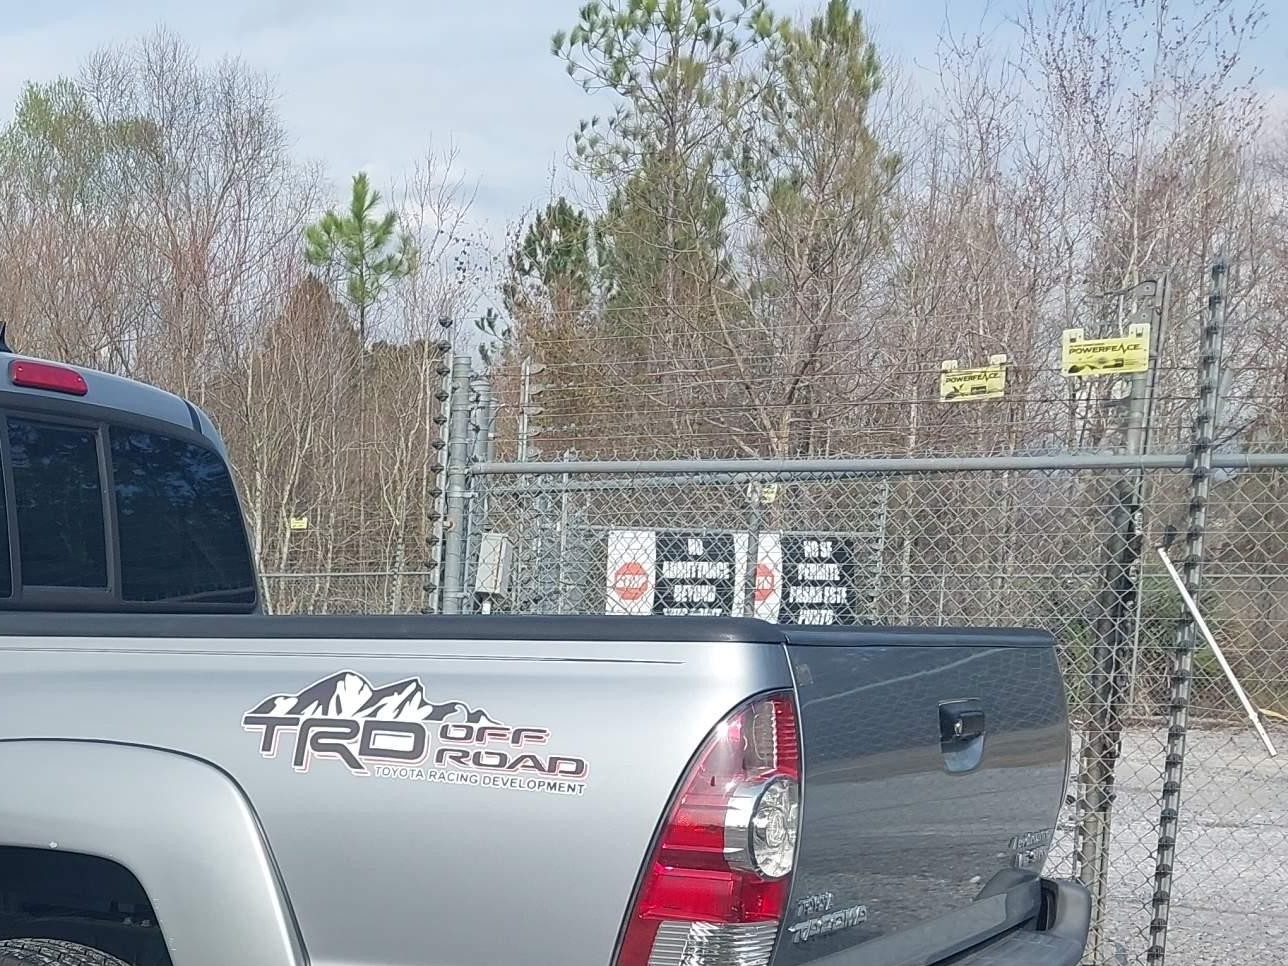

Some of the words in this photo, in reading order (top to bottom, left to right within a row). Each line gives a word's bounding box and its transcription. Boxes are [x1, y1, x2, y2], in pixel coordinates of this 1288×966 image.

[687, 538, 704, 556] NO
[243, 715, 428, 772] TRD
[439, 723, 550, 747] OFF
[435, 747, 588, 778] ROAD
[375, 766, 424, 780] TOYOTA
[428, 770, 479, 785] RACING
[482, 775, 586, 795] DEVELOPMENT
